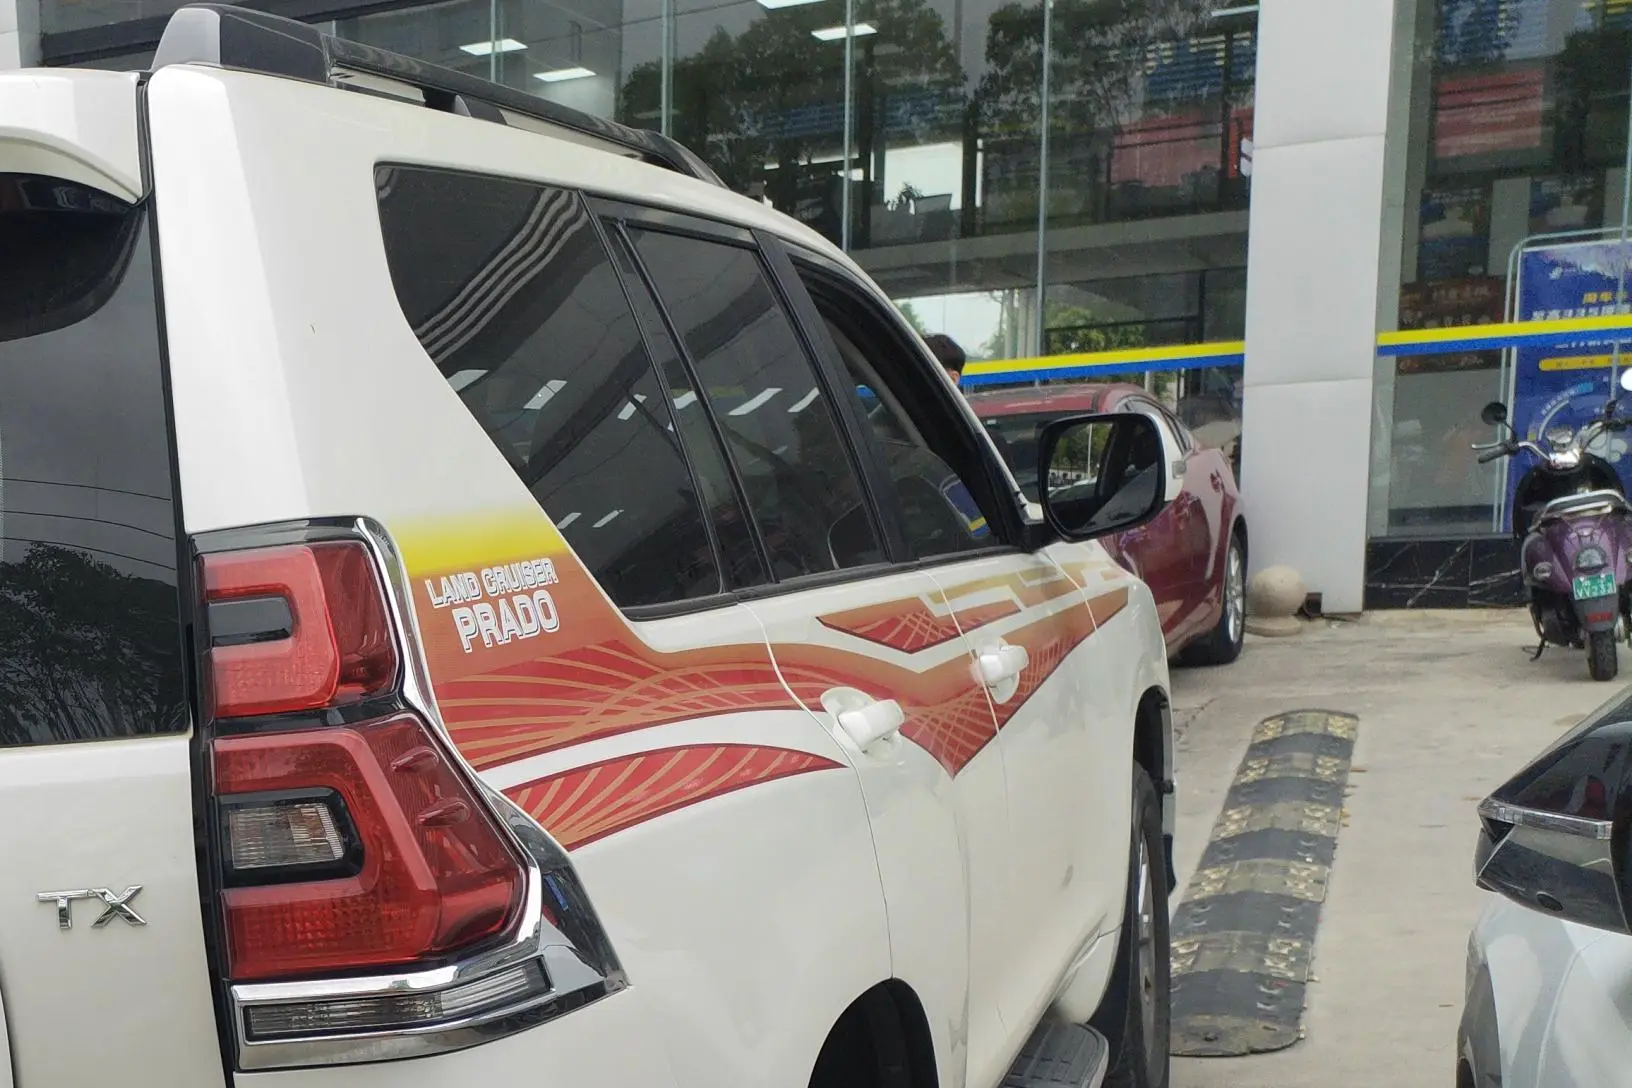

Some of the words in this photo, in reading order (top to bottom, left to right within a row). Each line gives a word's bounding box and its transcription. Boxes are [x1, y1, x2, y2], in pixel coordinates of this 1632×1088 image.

[425, 572, 483, 608] LAND
[481, 557, 559, 597] CRUISER
[452, 589, 560, 653] PRADO
[37, 884, 147, 929] TX
